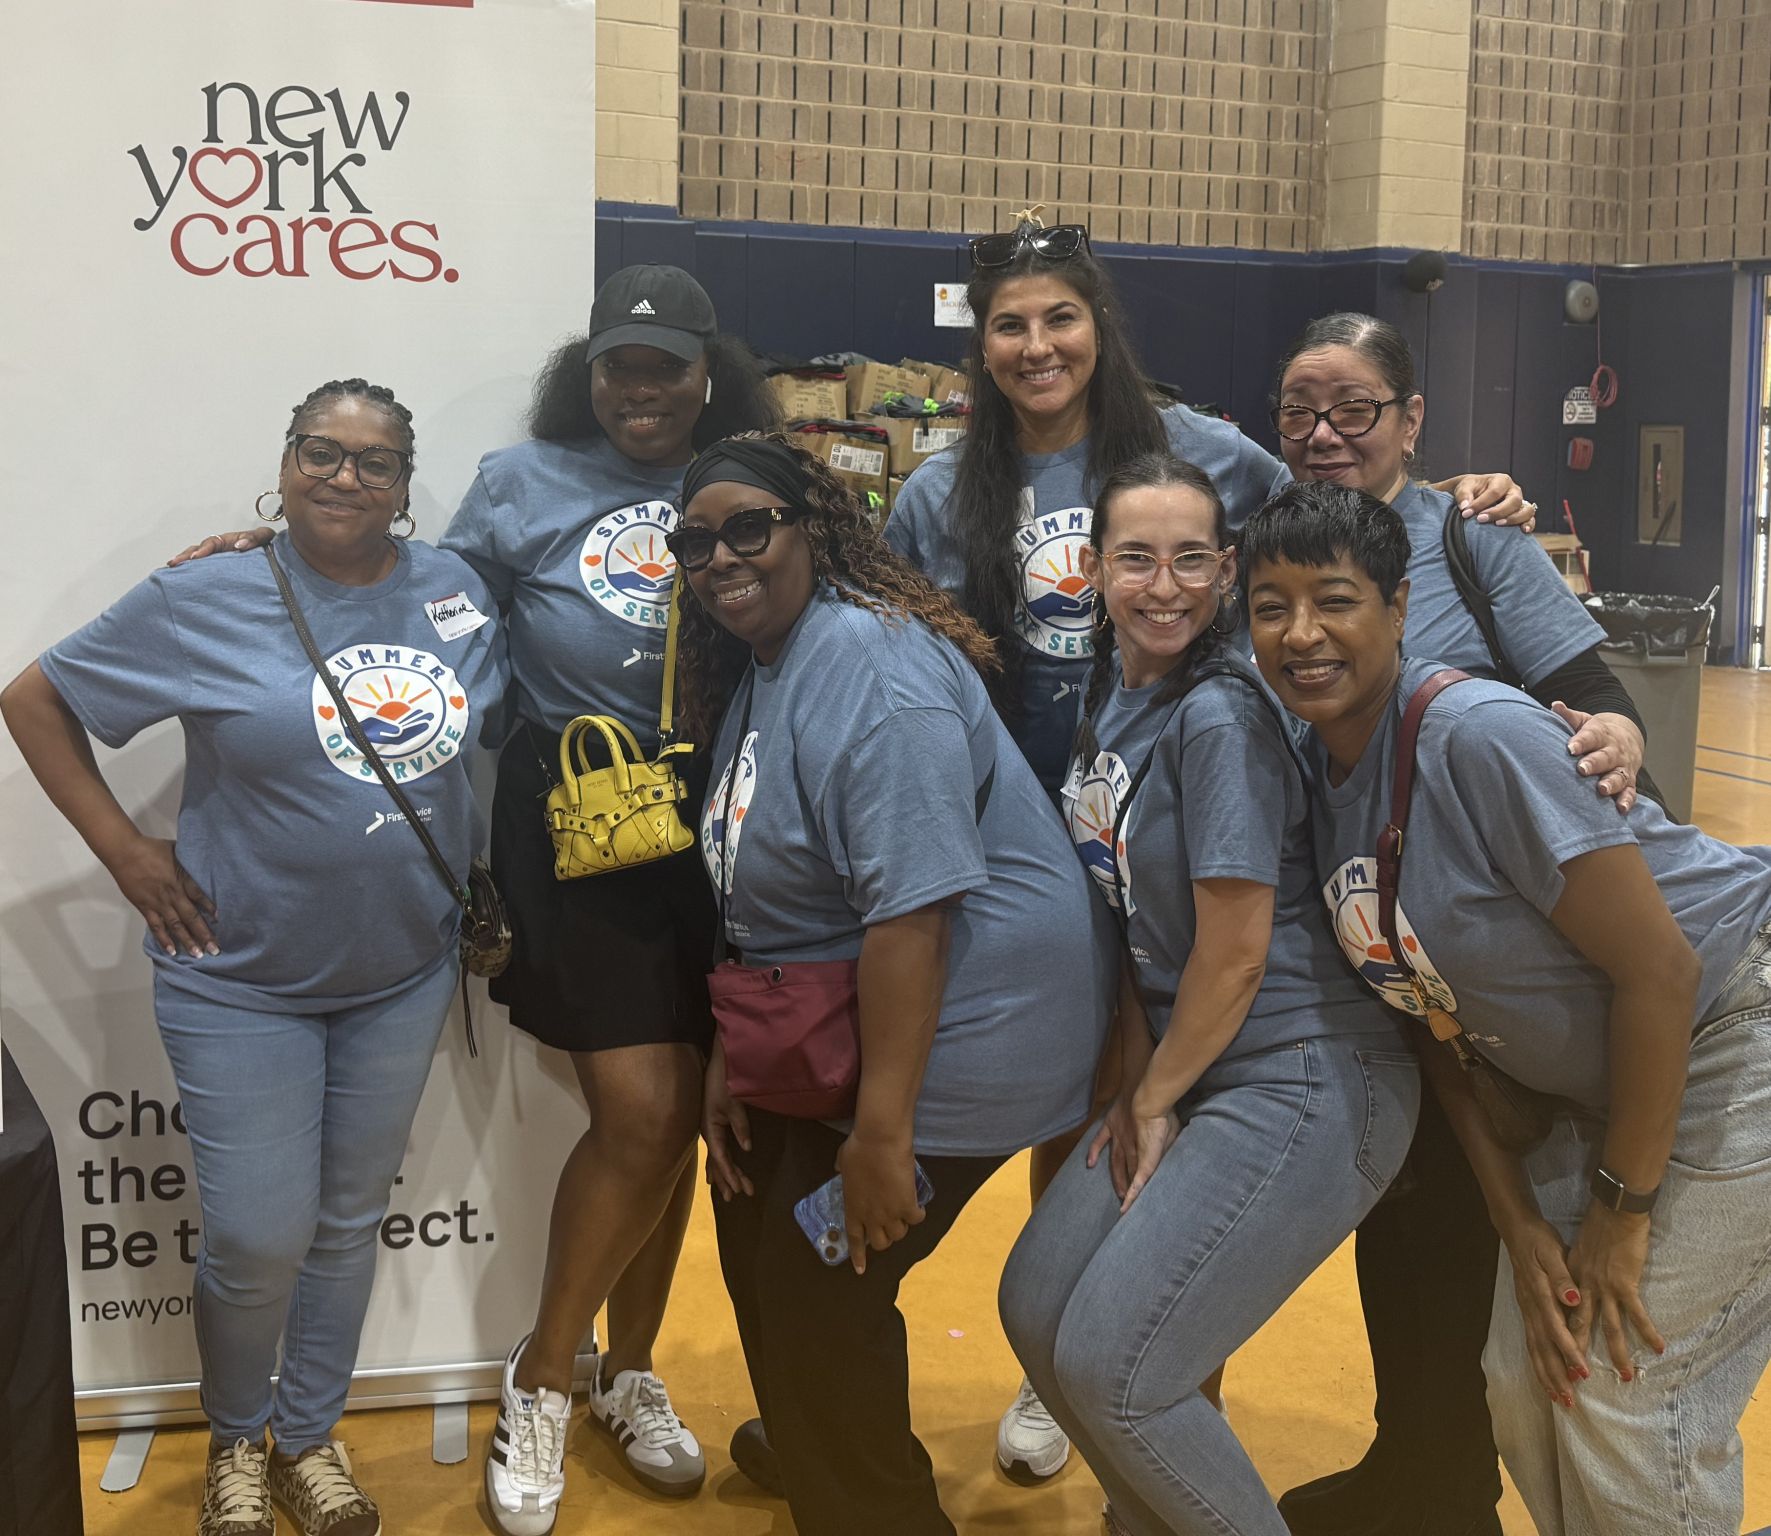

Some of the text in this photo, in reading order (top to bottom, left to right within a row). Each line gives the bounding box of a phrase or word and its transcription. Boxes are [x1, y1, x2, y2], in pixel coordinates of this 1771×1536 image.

[201, 81, 410, 151] new
[170, 213, 459, 283] cares.
[596, 504, 672, 538] SUMM
[1019, 512, 1084, 546] UMM
[623, 601, 667, 625] SER
[1047, 633, 1095, 656] SER
[332, 649, 446, 687] UMMER
[326, 725, 461, 780] OF SRVICE
[78, 1157, 186, 1205] the
[82, 1200, 494, 1271] Be t ect.
[82, 1296, 193, 1325] newyor
